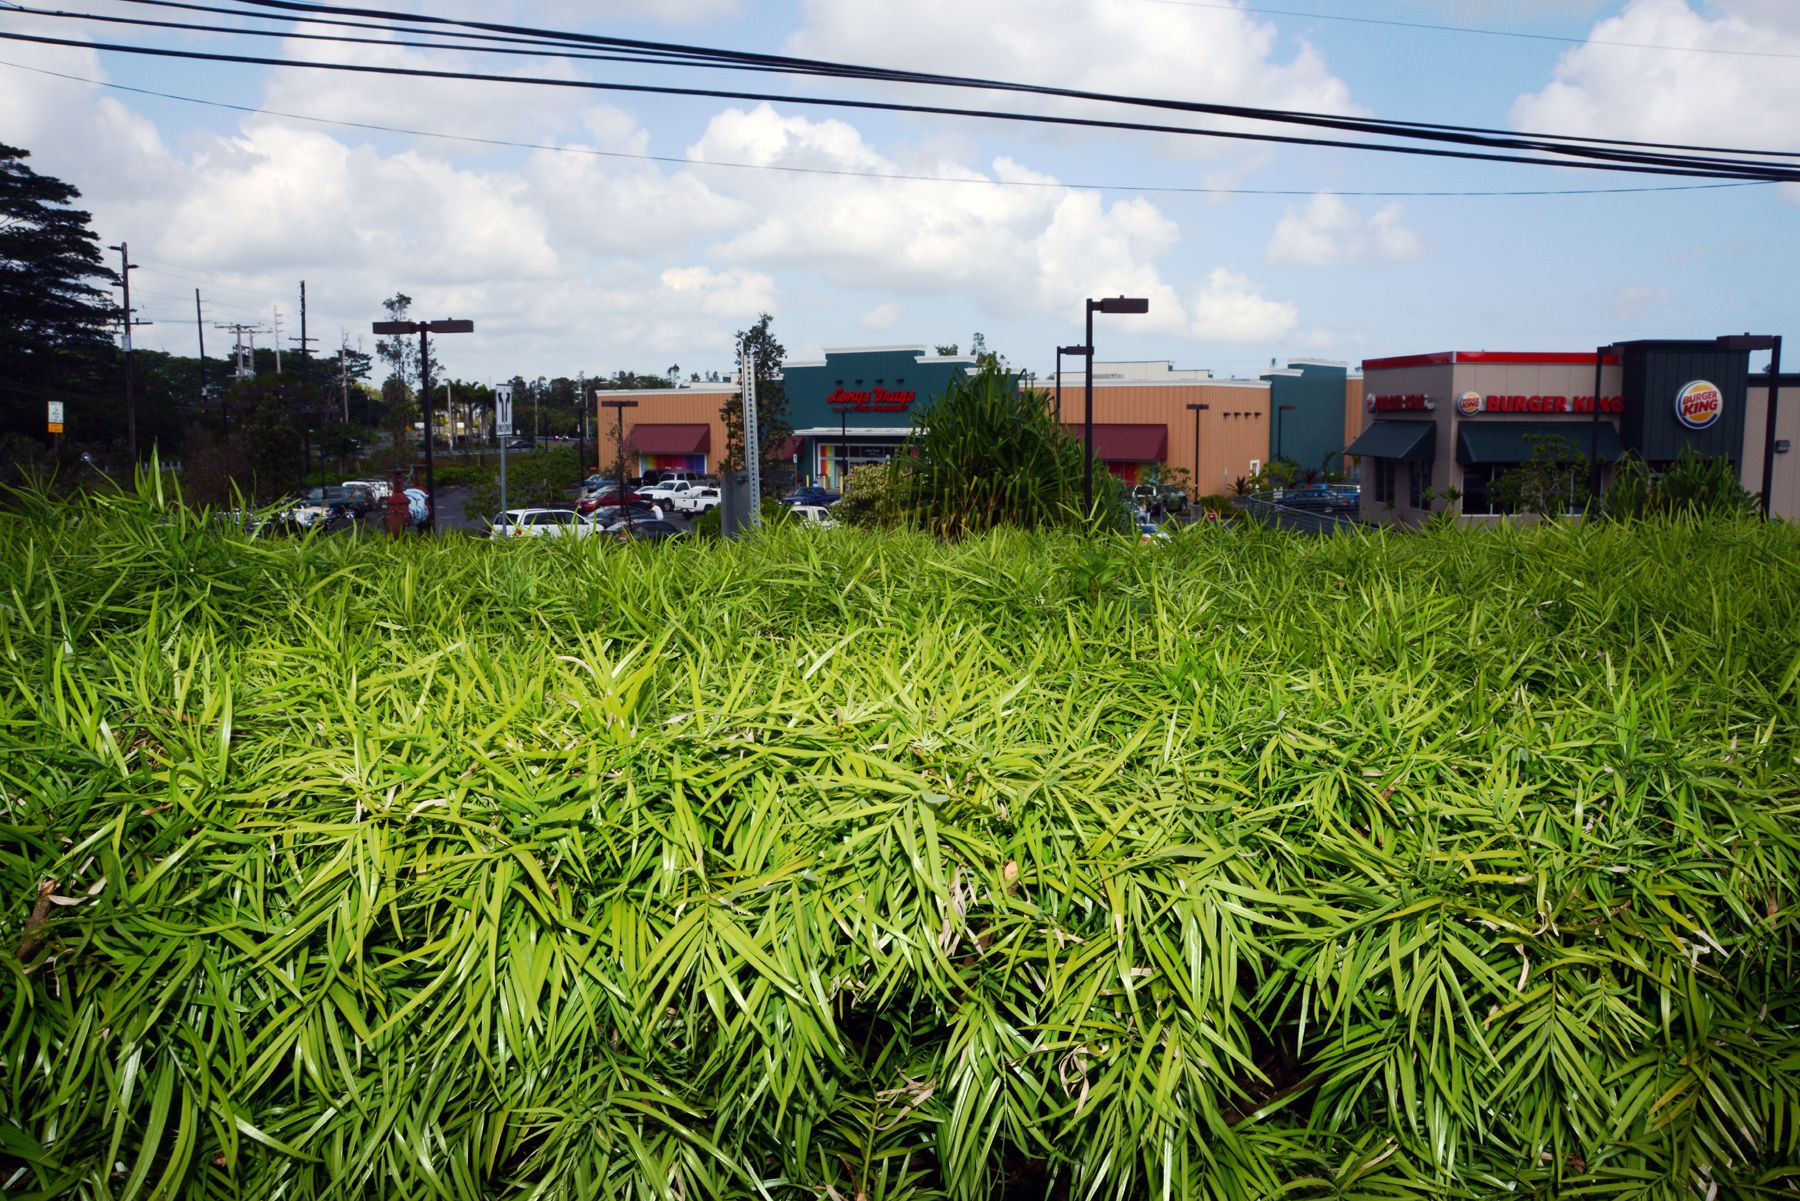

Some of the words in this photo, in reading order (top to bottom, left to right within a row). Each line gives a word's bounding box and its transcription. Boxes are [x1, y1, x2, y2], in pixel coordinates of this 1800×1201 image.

[826, 387, 871, 404] Longs
[873, 386, 915, 405] Drugs
[1486, 395, 1567, 412] BURGER
[1572, 395, 1625, 412] KING
[1682, 390, 1718, 405] BURGER
[1682, 399, 1718, 417] KING
